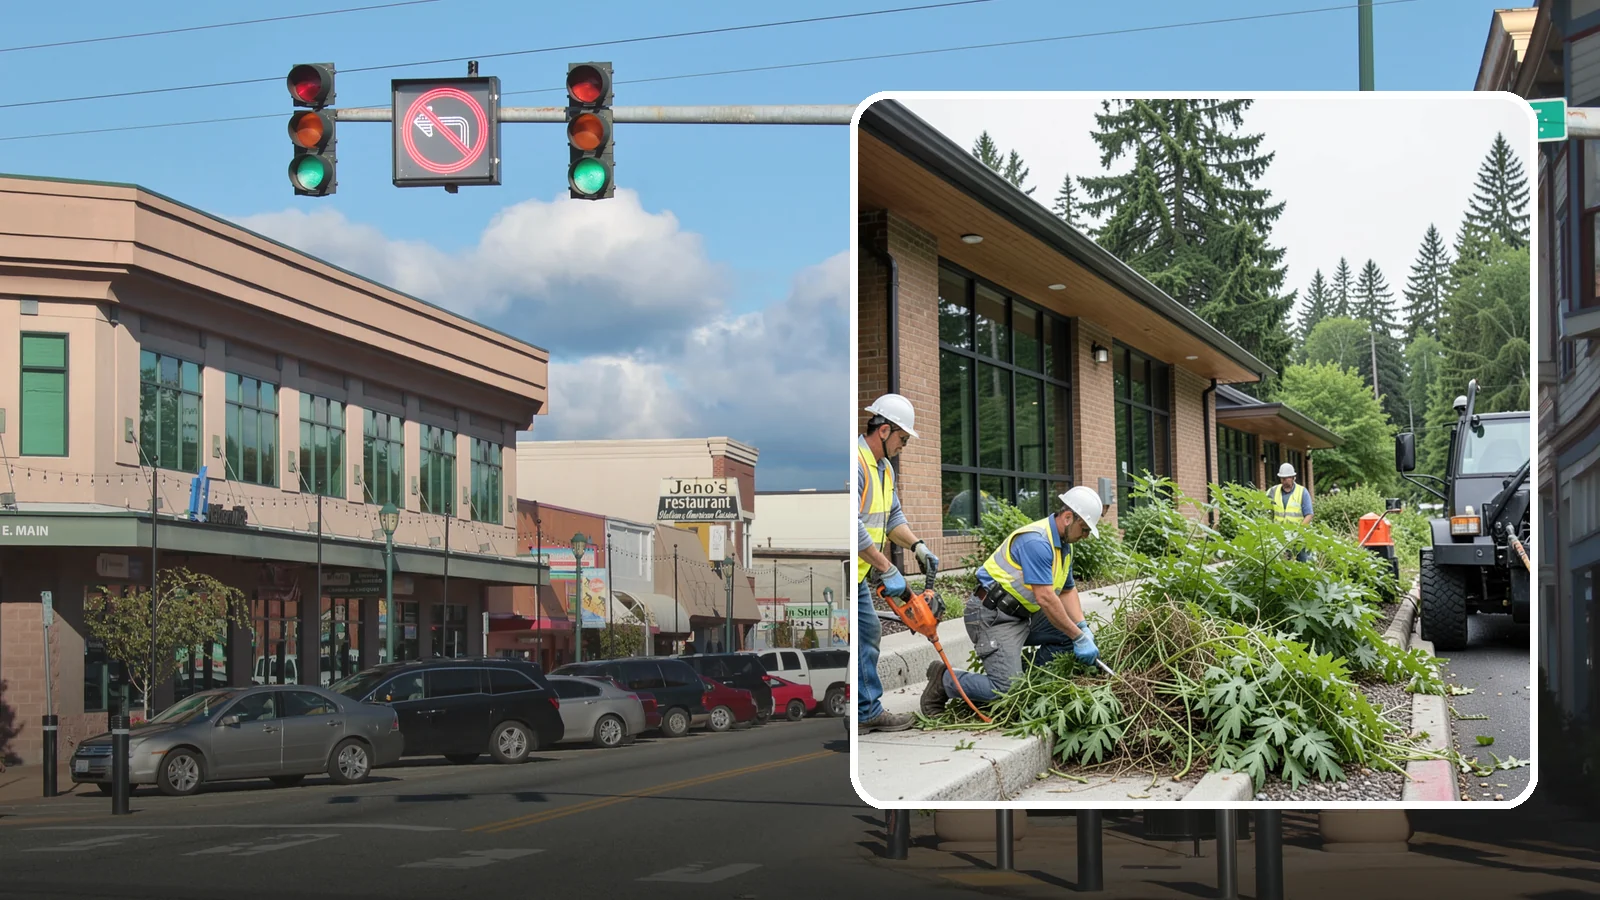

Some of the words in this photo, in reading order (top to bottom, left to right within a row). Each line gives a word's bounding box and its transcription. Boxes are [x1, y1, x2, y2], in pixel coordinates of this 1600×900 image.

[669, 480, 727, 494] Jeno's
[665, 496, 731, 509] restaurant
[658, 510, 682, 519] Italian
[686, 510, 714, 519] American
[715, 509, 738, 519] Cuisine
[2, 525, 13, 536] E.
[15, 525, 49, 536] MAIN
[797, 607, 829, 617] Street
